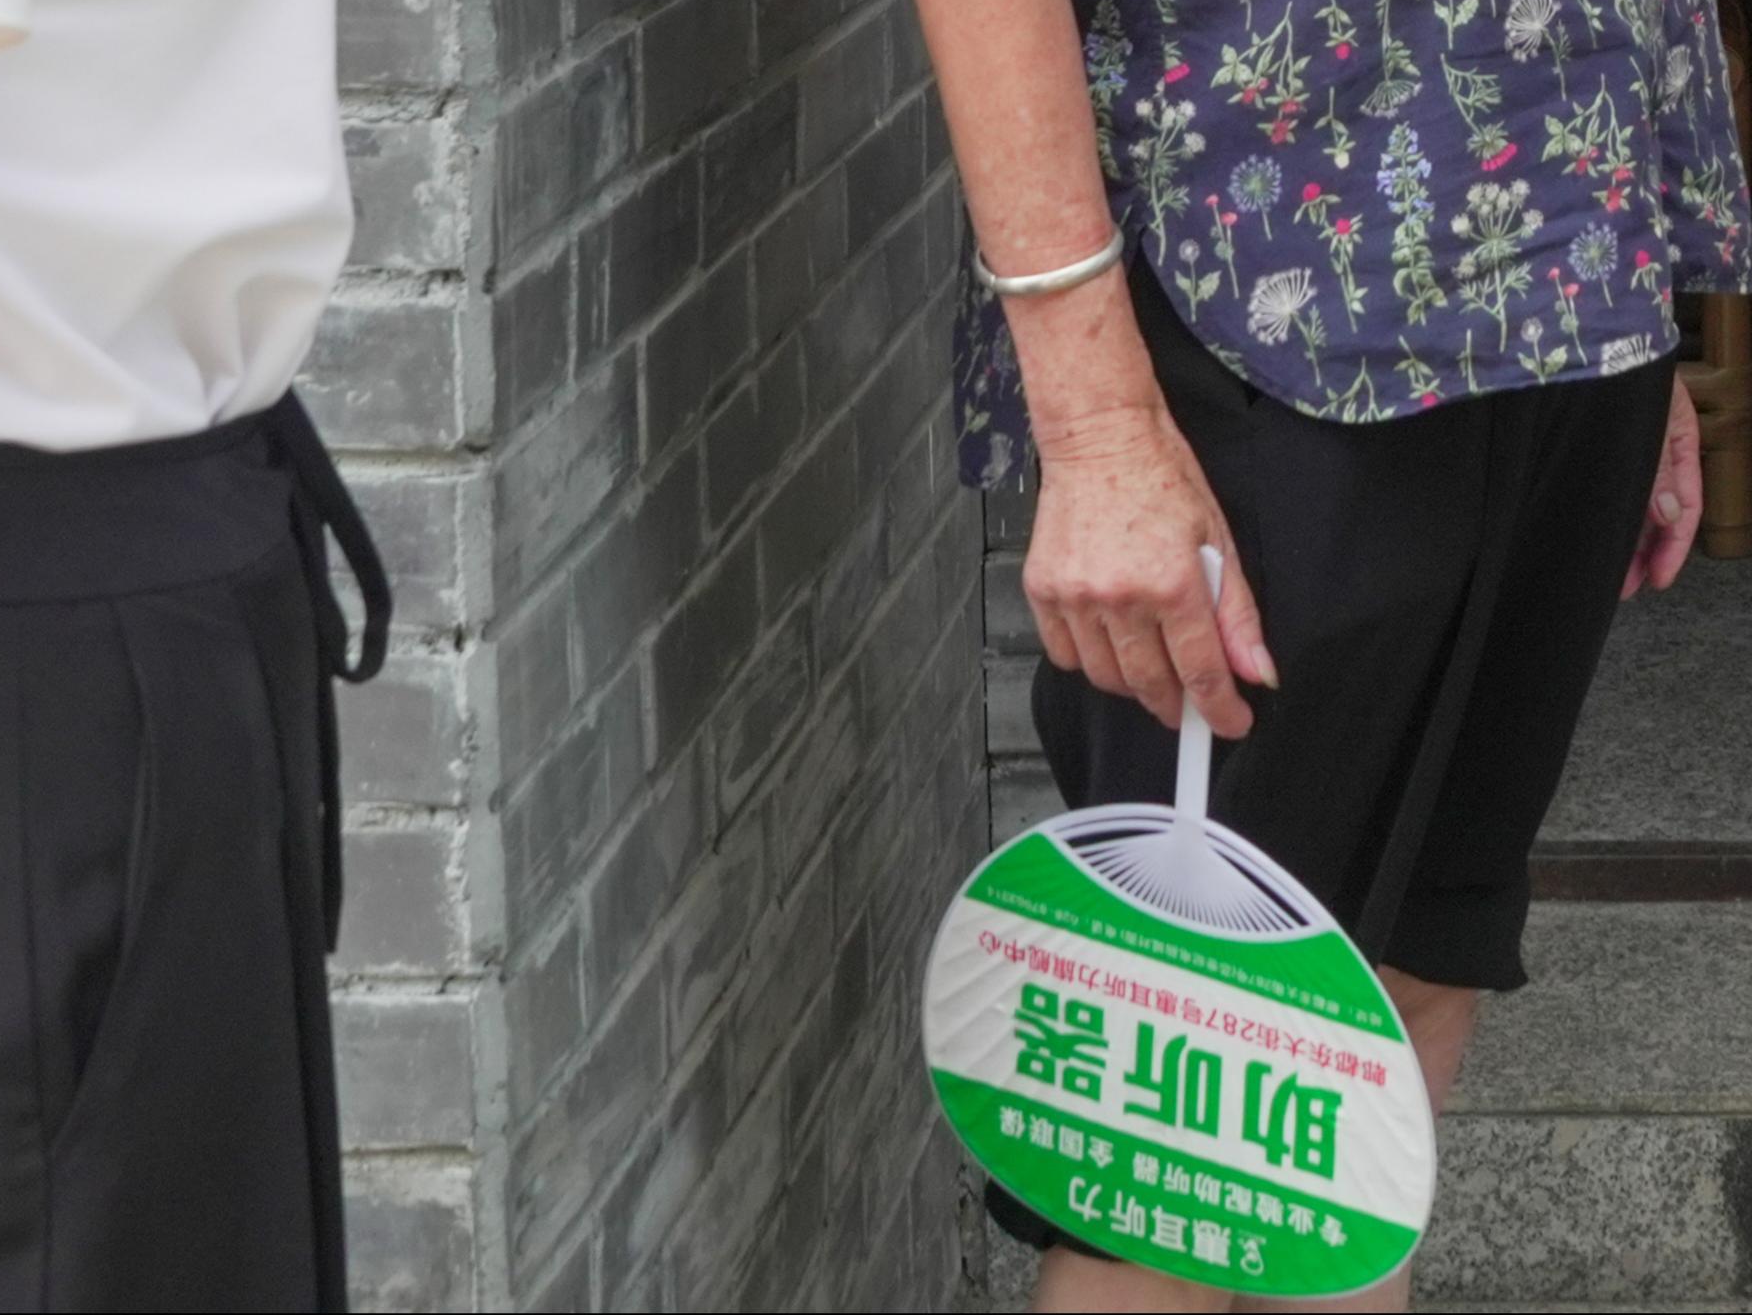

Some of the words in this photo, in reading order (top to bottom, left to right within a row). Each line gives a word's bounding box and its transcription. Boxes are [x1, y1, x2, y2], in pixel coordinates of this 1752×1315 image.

[979, 930, 1386, 1087] 郫都东大街287号惠耳听力旗舰中心
[1013, 982, 1343, 1181] 助听器
[998, 1107, 1114, 1167] 全国联保
[1068, 1176, 1231, 1267] 惠耳听力
[1131, 1151, 1348, 1248] 专业验配助听器
